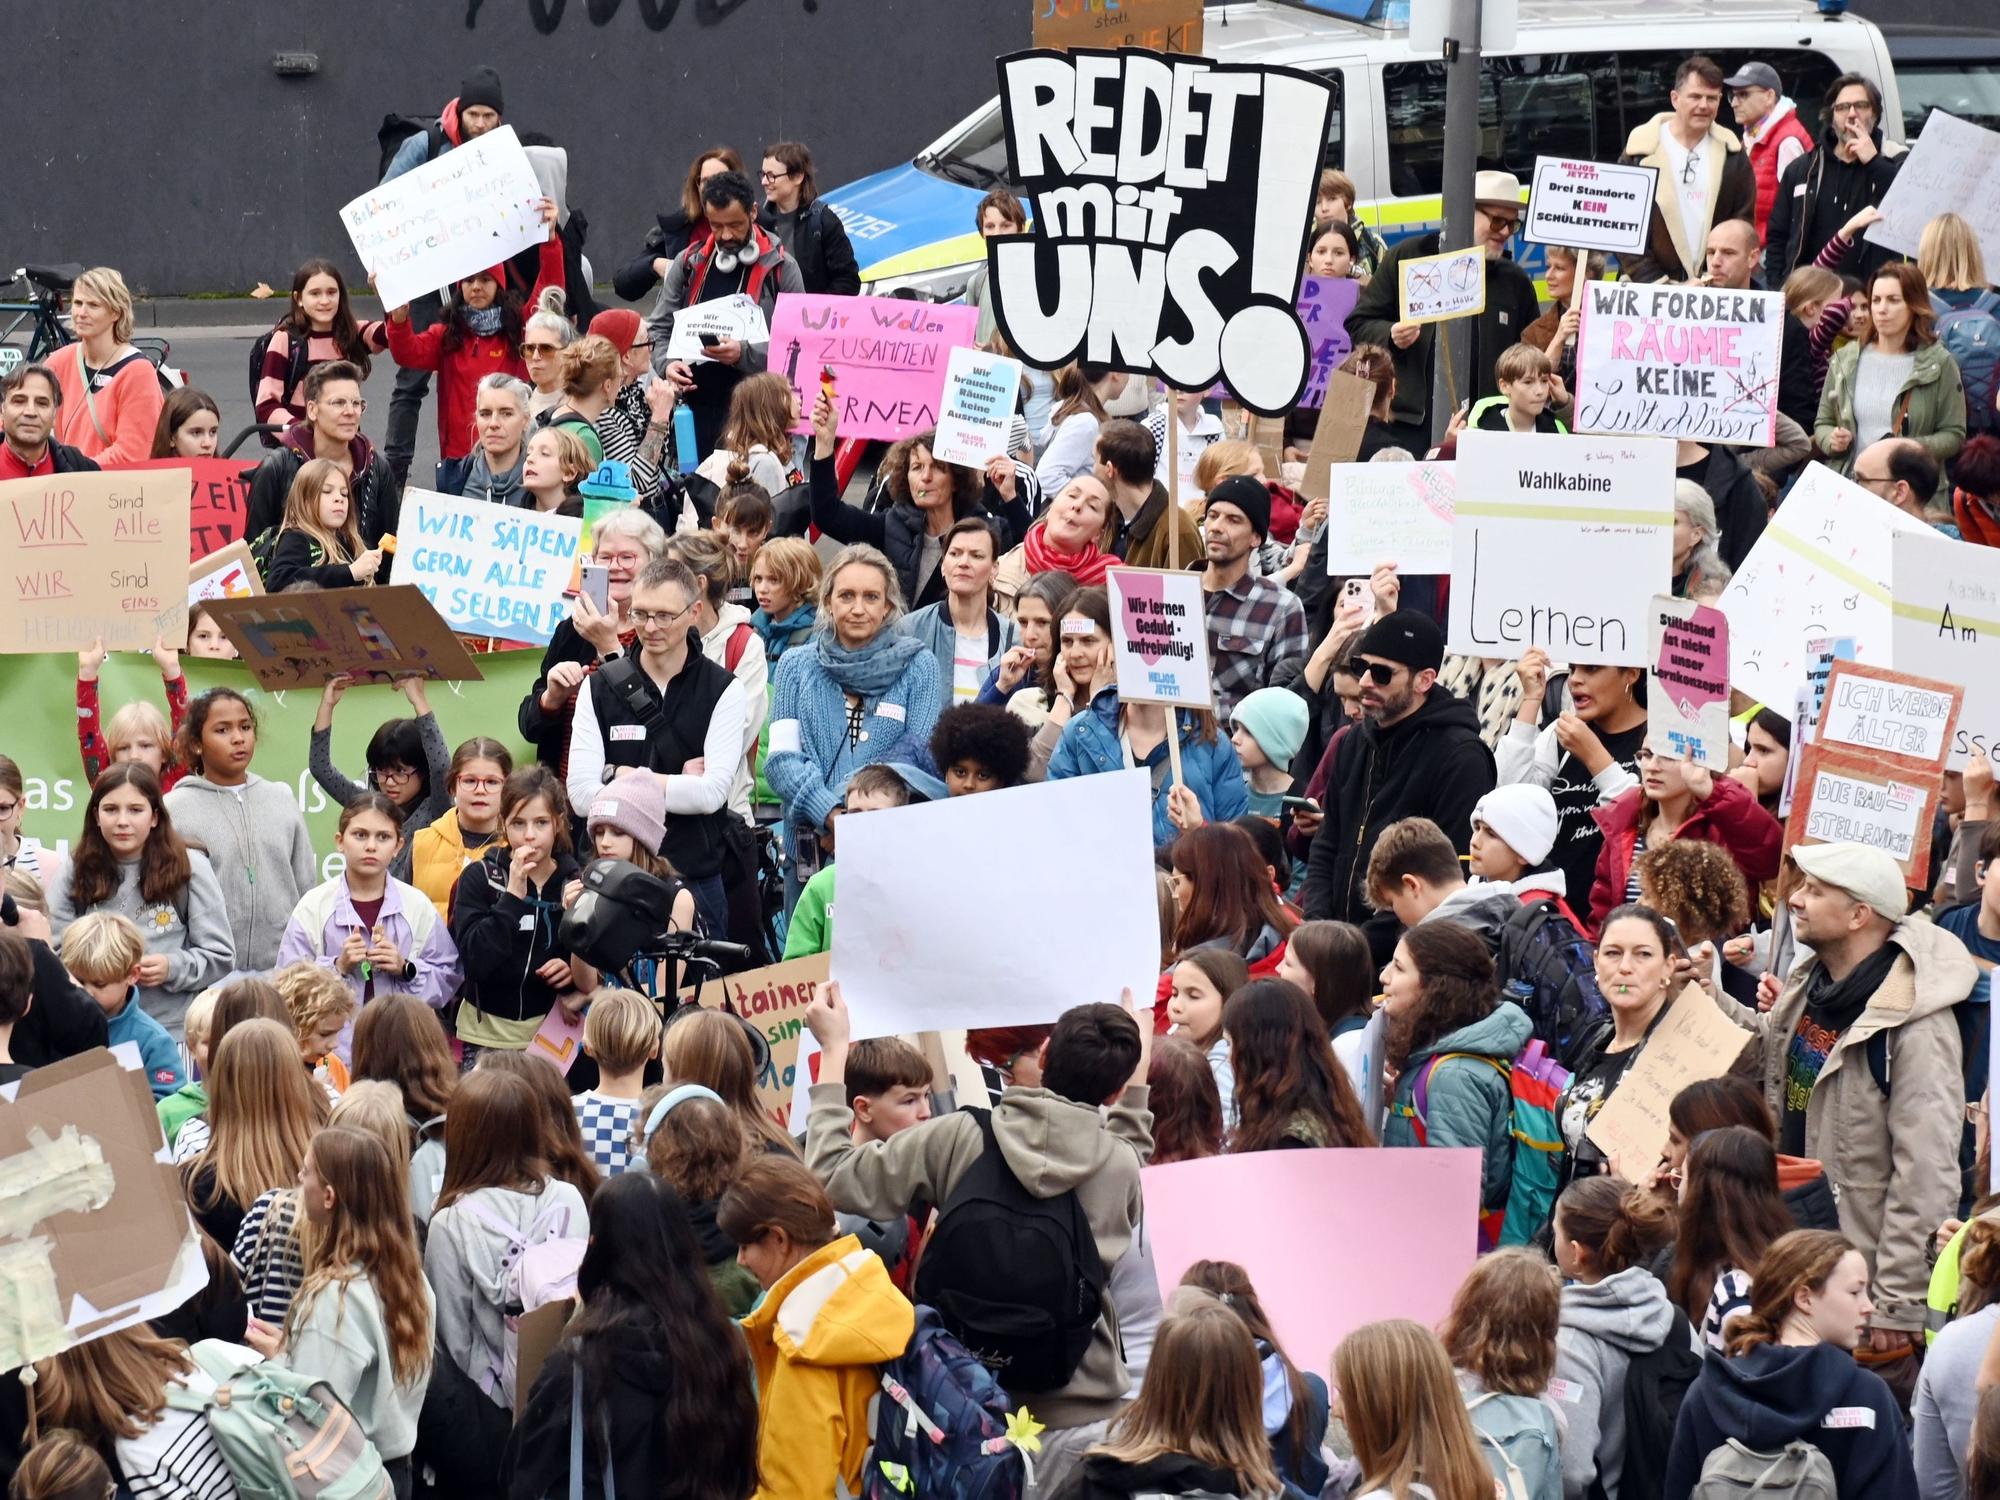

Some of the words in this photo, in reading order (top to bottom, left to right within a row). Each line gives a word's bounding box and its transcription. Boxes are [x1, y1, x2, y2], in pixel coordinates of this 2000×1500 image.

[1005, 55, 1261, 189] REDET
[1560, 162, 1596, 173] HELIOS
[1567, 170, 1600, 181] JETZT!
[1549, 182, 1574, 193] Drei
[1576, 185, 1636, 200] Standorte
[1037, 182, 1183, 245] mit
[1572, 200, 1608, 213] KEIN
[1536, 212, 1640, 232] SCHÜLERTICKET!
[1593, 282, 1640, 317] WIR
[1651, 291, 1767, 324] FORDERN
[687, 322, 734, 332] verdienen
[704, 313, 720, 321] Wir
[802, 305, 850, 331] Wir
[819, 337, 939, 367] ZUSAMMEN
[1611, 317, 1742, 369] RÄUME
[972, 366, 992, 377] Wir
[1636, 363, 1718, 399] KEINE
[953, 374, 1006, 394] brauchen
[958, 388, 996, 404] Räume
[947, 409, 1003, 429] Ausreden!
[960, 400, 991, 414] keine
[1580, 379, 1765, 442] Luftschlösser
[1518, 470, 1612, 493] Wahlkabine
[12, 490, 84, 542] WIR
[108, 487, 144, 510] Sind
[114, 511, 163, 537] Alle
[418, 505, 475, 542] WIR
[491, 517, 577, 565] SÄßEN
[16, 570, 70, 596] WIR
[110, 562, 149, 589] Sind
[411, 547, 473, 577] GERN
[484, 561, 547, 590] ALLE
[1471, 528, 1626, 653] Lernen
[121, 597, 159, 610] EINS
[450, 587, 541, 628] SELBEN
[1127, 597, 1147, 613] Wir
[1149, 598, 1186, 617] lernen
[1135, 618, 1174, 636] Geduld
[1659, 613, 1715, 639] Stillstand
[1938, 602, 1977, 644] Am
[1127, 637, 1195, 661] unfreiwillig!
[1681, 640, 1711, 656] nicht
[1670, 653, 1705, 672] unser
[1148, 671, 1176, 683] HELIOS
[1651, 664, 1725, 696] Lernkonzept!
[1154, 684, 1181, 697] JETZT!
[1838, 682, 1885, 713] ICH
[1888, 689, 1952, 720] WERDE
[1847, 714, 1928, 753] ÄLTER
[1674, 743, 1706, 760] JEZT!
[1817, 777, 1851, 804] DIE
